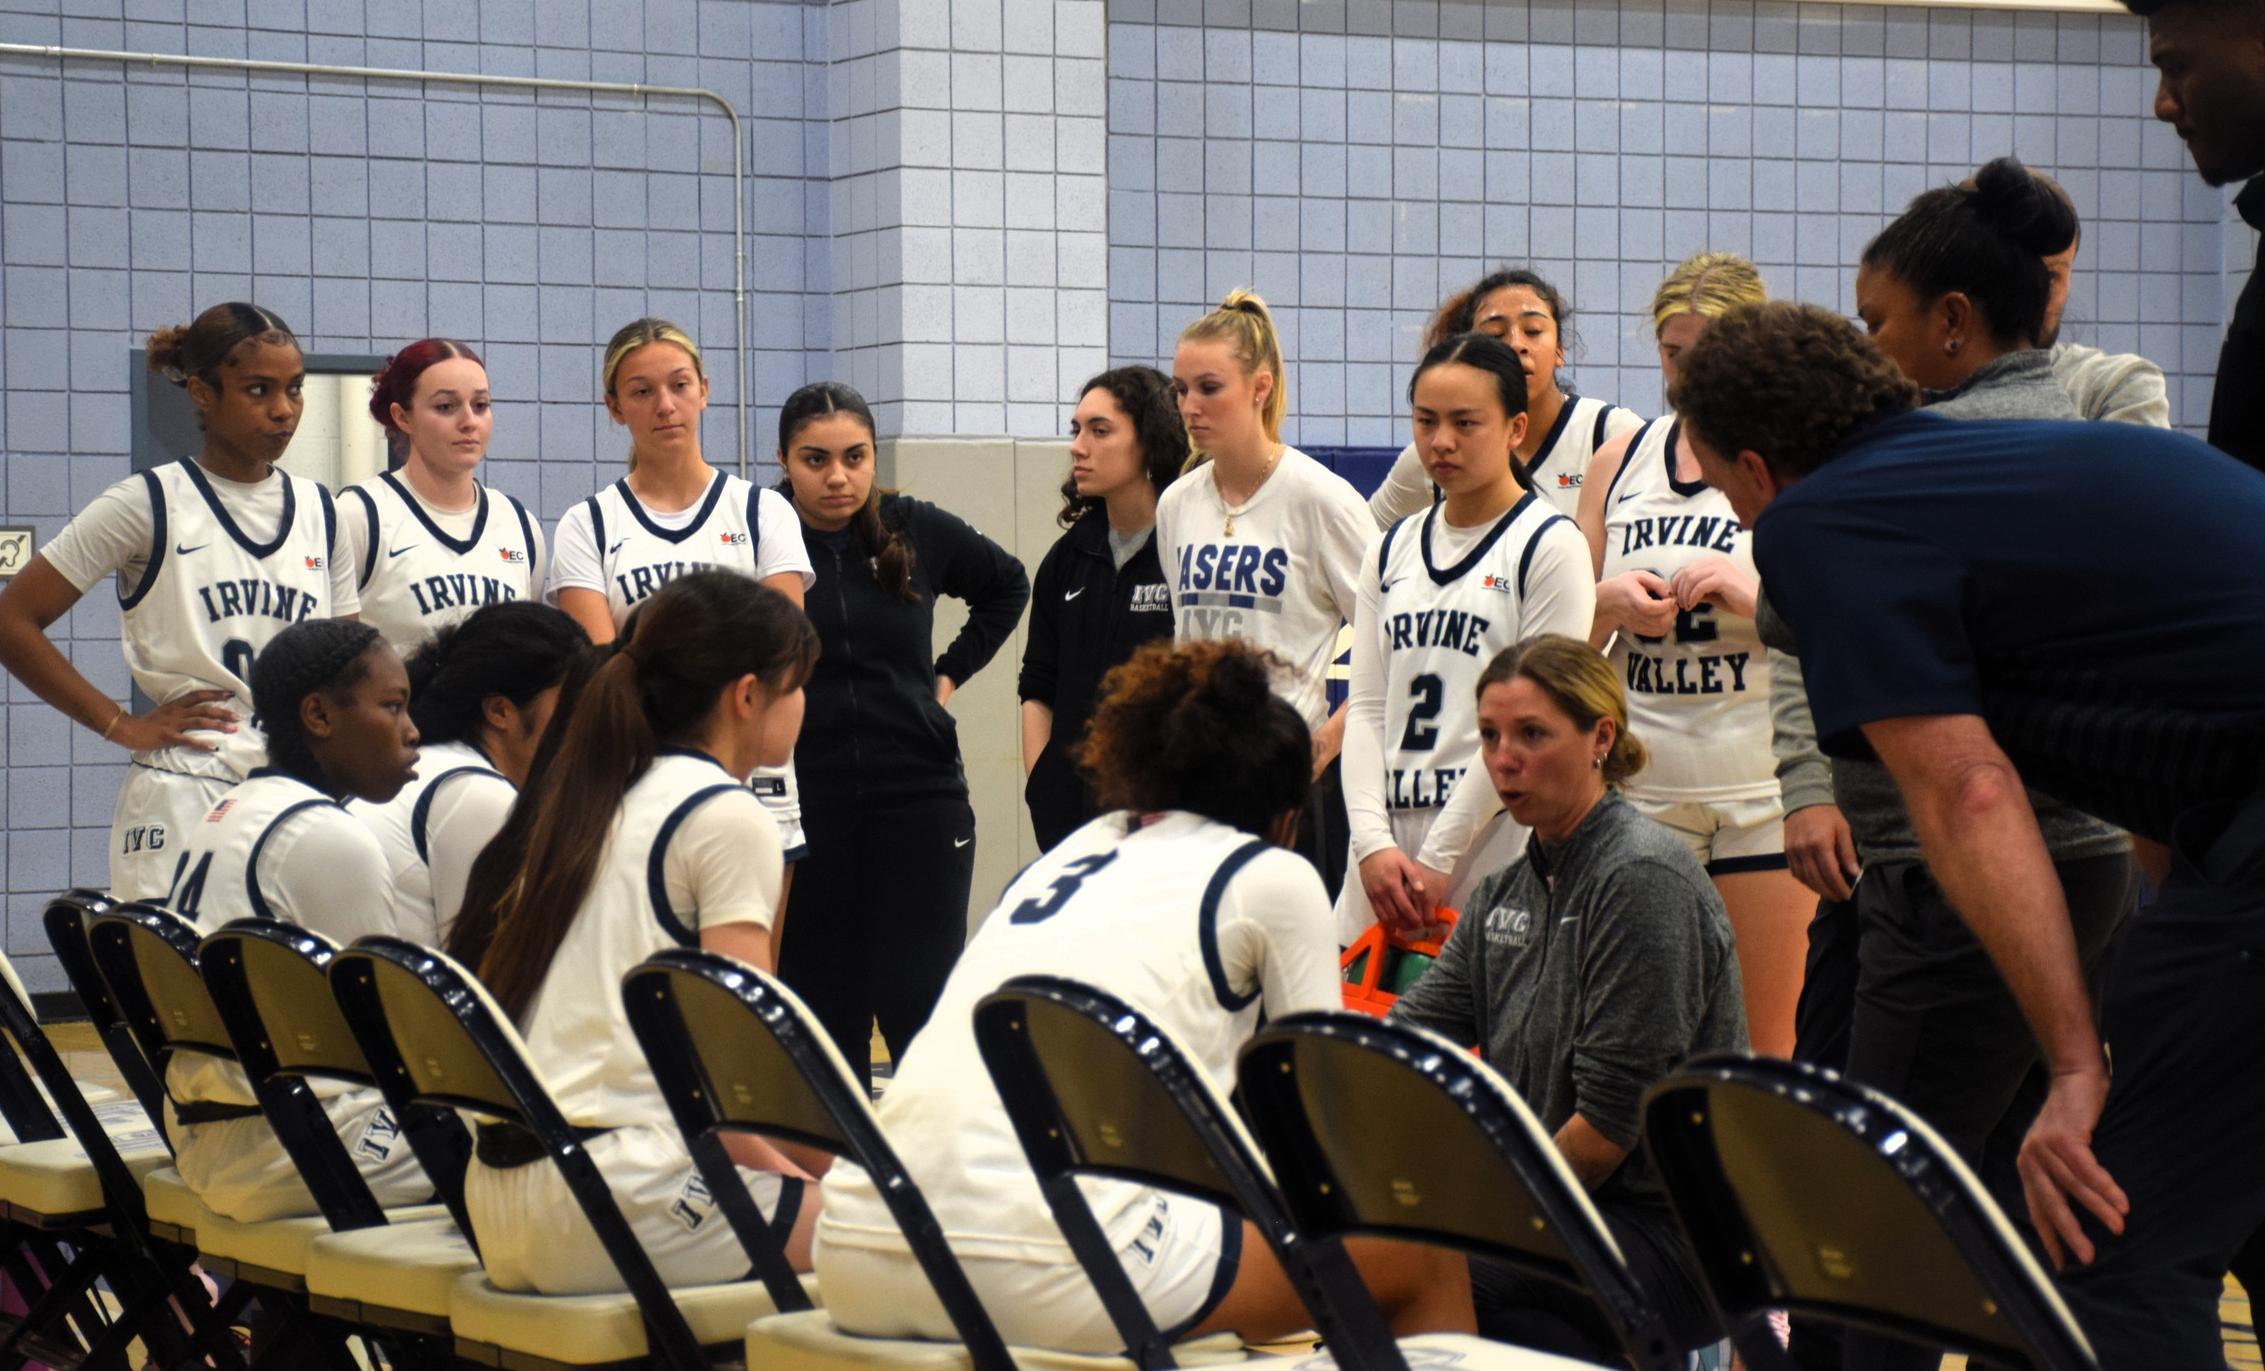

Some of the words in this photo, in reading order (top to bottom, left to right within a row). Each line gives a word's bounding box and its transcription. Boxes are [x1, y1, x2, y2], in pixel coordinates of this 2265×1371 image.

[1622, 514, 1743, 557] IRVINE
[616, 561, 713, 607] IRV
[1177, 543, 1289, 598] ASERS
[1131, 583, 1169, 603] IVC
[1180, 609, 1244, 641] IVC
[1626, 651, 1749, 694] VALLEY
[1399, 672, 1443, 751] 2
[122, 824, 165, 855] IVC
[1009, 847, 1119, 926] 3
[1485, 907, 1531, 933] IVC
[358, 1108, 401, 1161] IV
[672, 1175, 713, 1230] IV
